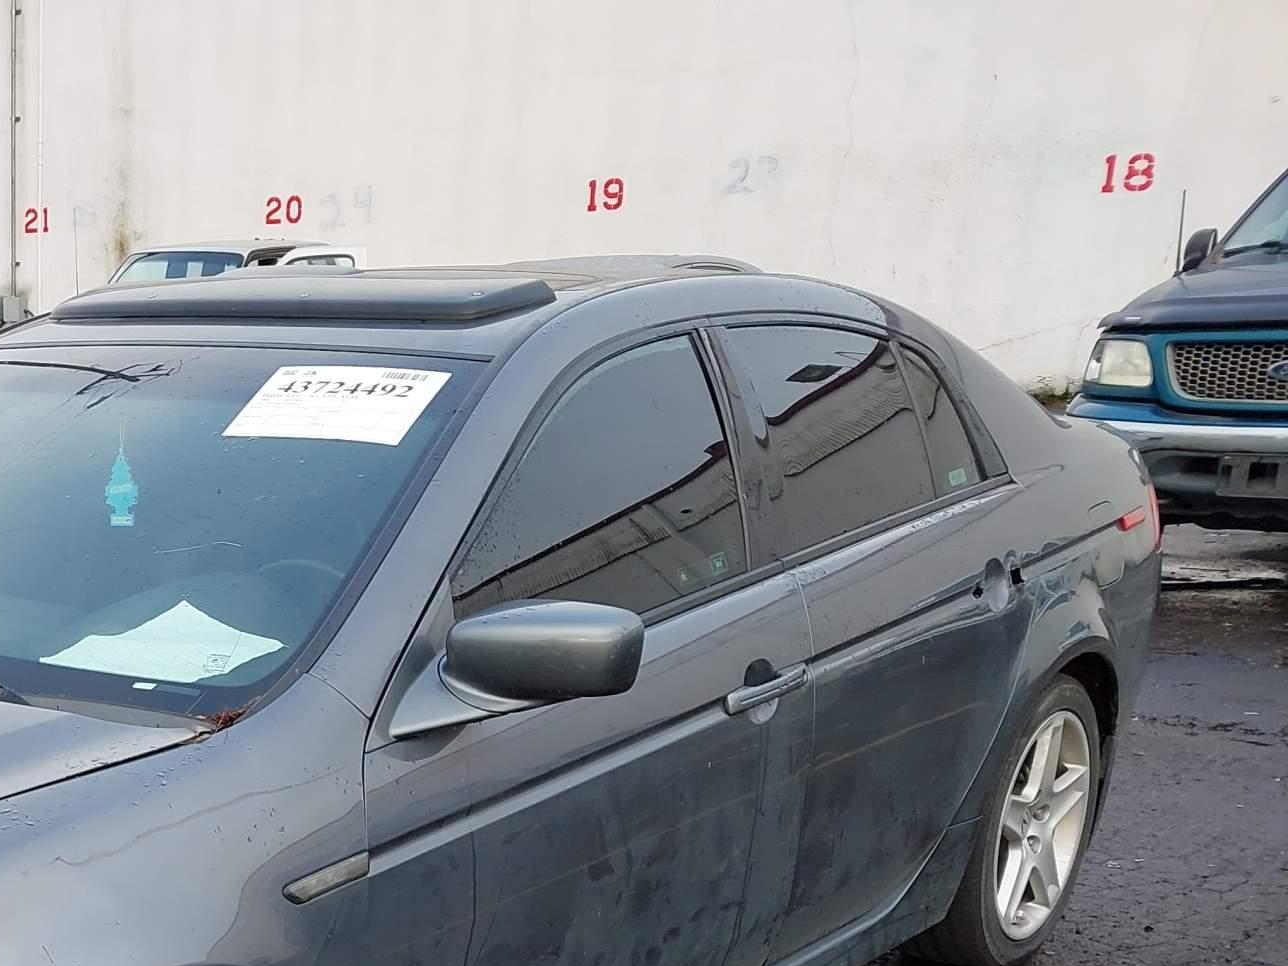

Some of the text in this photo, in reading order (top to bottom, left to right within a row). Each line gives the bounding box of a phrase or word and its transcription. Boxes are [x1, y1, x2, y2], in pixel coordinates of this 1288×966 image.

[1101, 153, 1155, 193] 18
[587, 177, 625, 212] 19
[24, 207, 49, 234] 21
[265, 195, 302, 225] 20
[278, 380, 414, 398] 43724492
